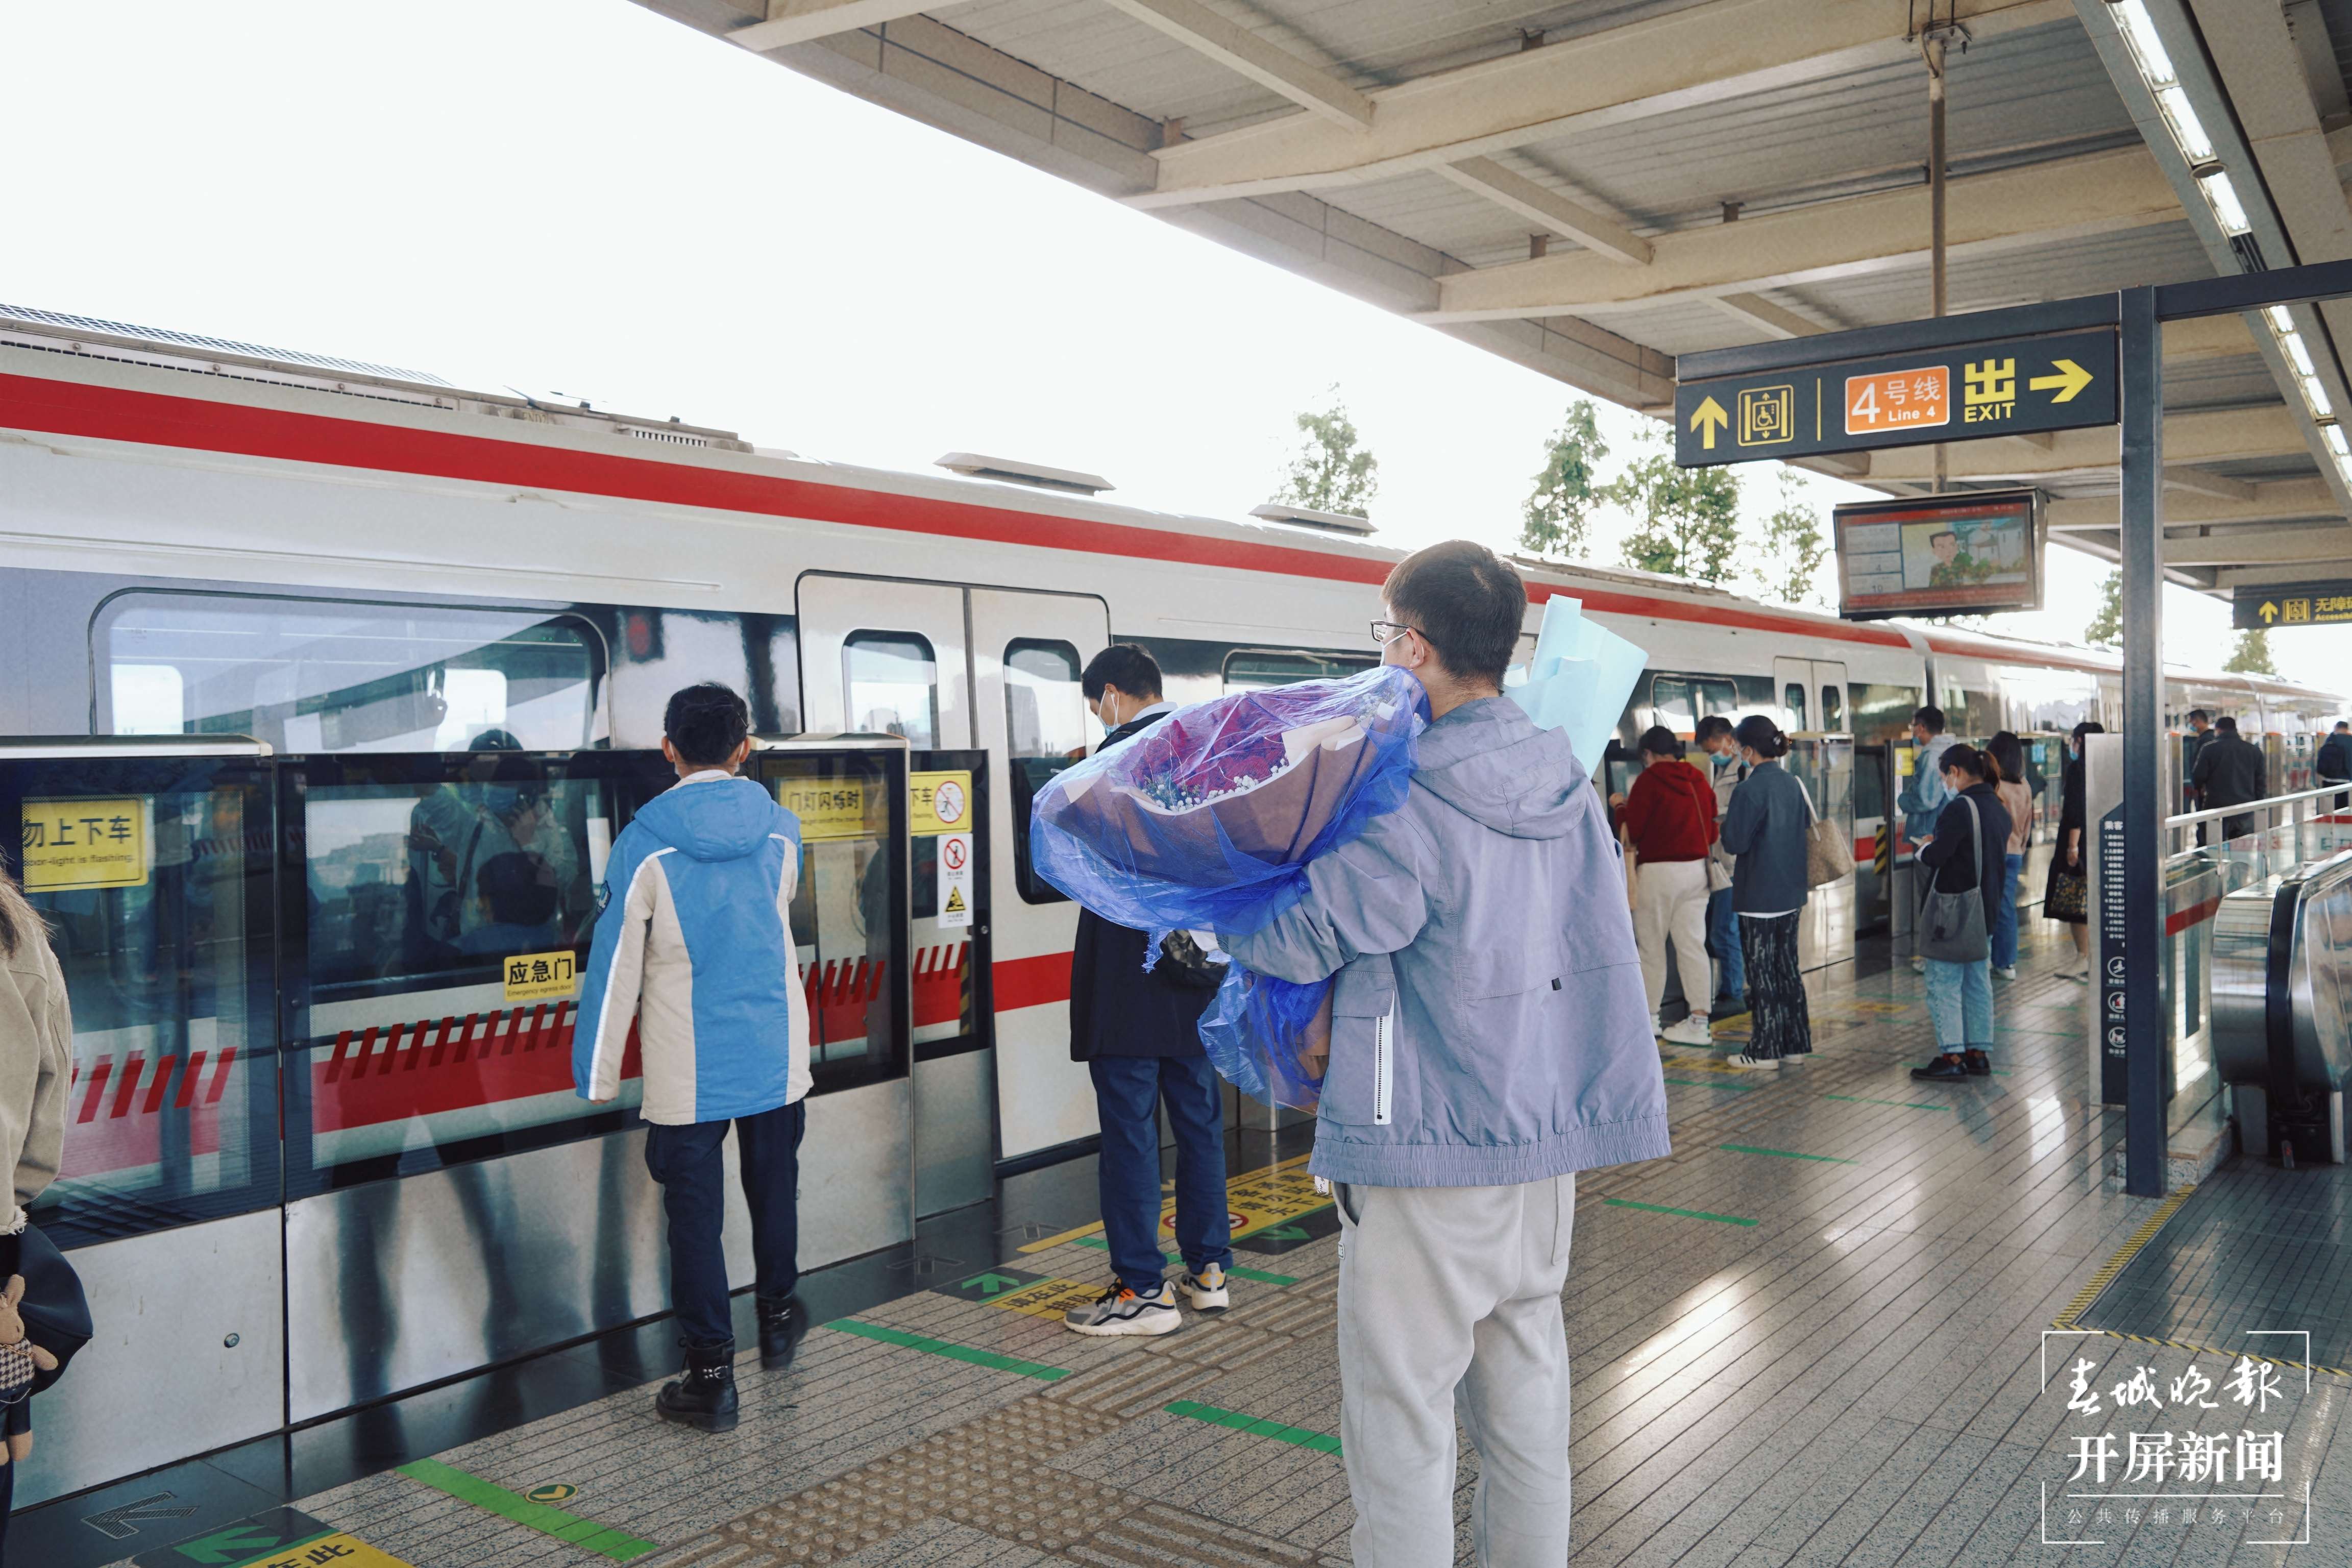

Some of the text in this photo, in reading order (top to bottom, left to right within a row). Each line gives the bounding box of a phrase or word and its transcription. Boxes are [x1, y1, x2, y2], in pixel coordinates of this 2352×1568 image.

[1965, 358, 2015, 405] 出
[1851, 376, 1941, 424] 4号线
[1965, 402, 2015, 423] EXIT
[1889, 406, 1935, 422] Line 4
[790, 790, 860, 812] 门灯闪烁时
[23, 816, 132, 848] 勿上下车
[508, 958, 572, 986] 应急门
[507, 989, 538, 997] Emergency
[1227, 1175, 1307, 1204] 客通道
[1235, 1180, 1315, 1210] 请勿站
[1002, 1283, 1079, 1308] 请在此
[1045, 1293, 1092, 1312] 排队
